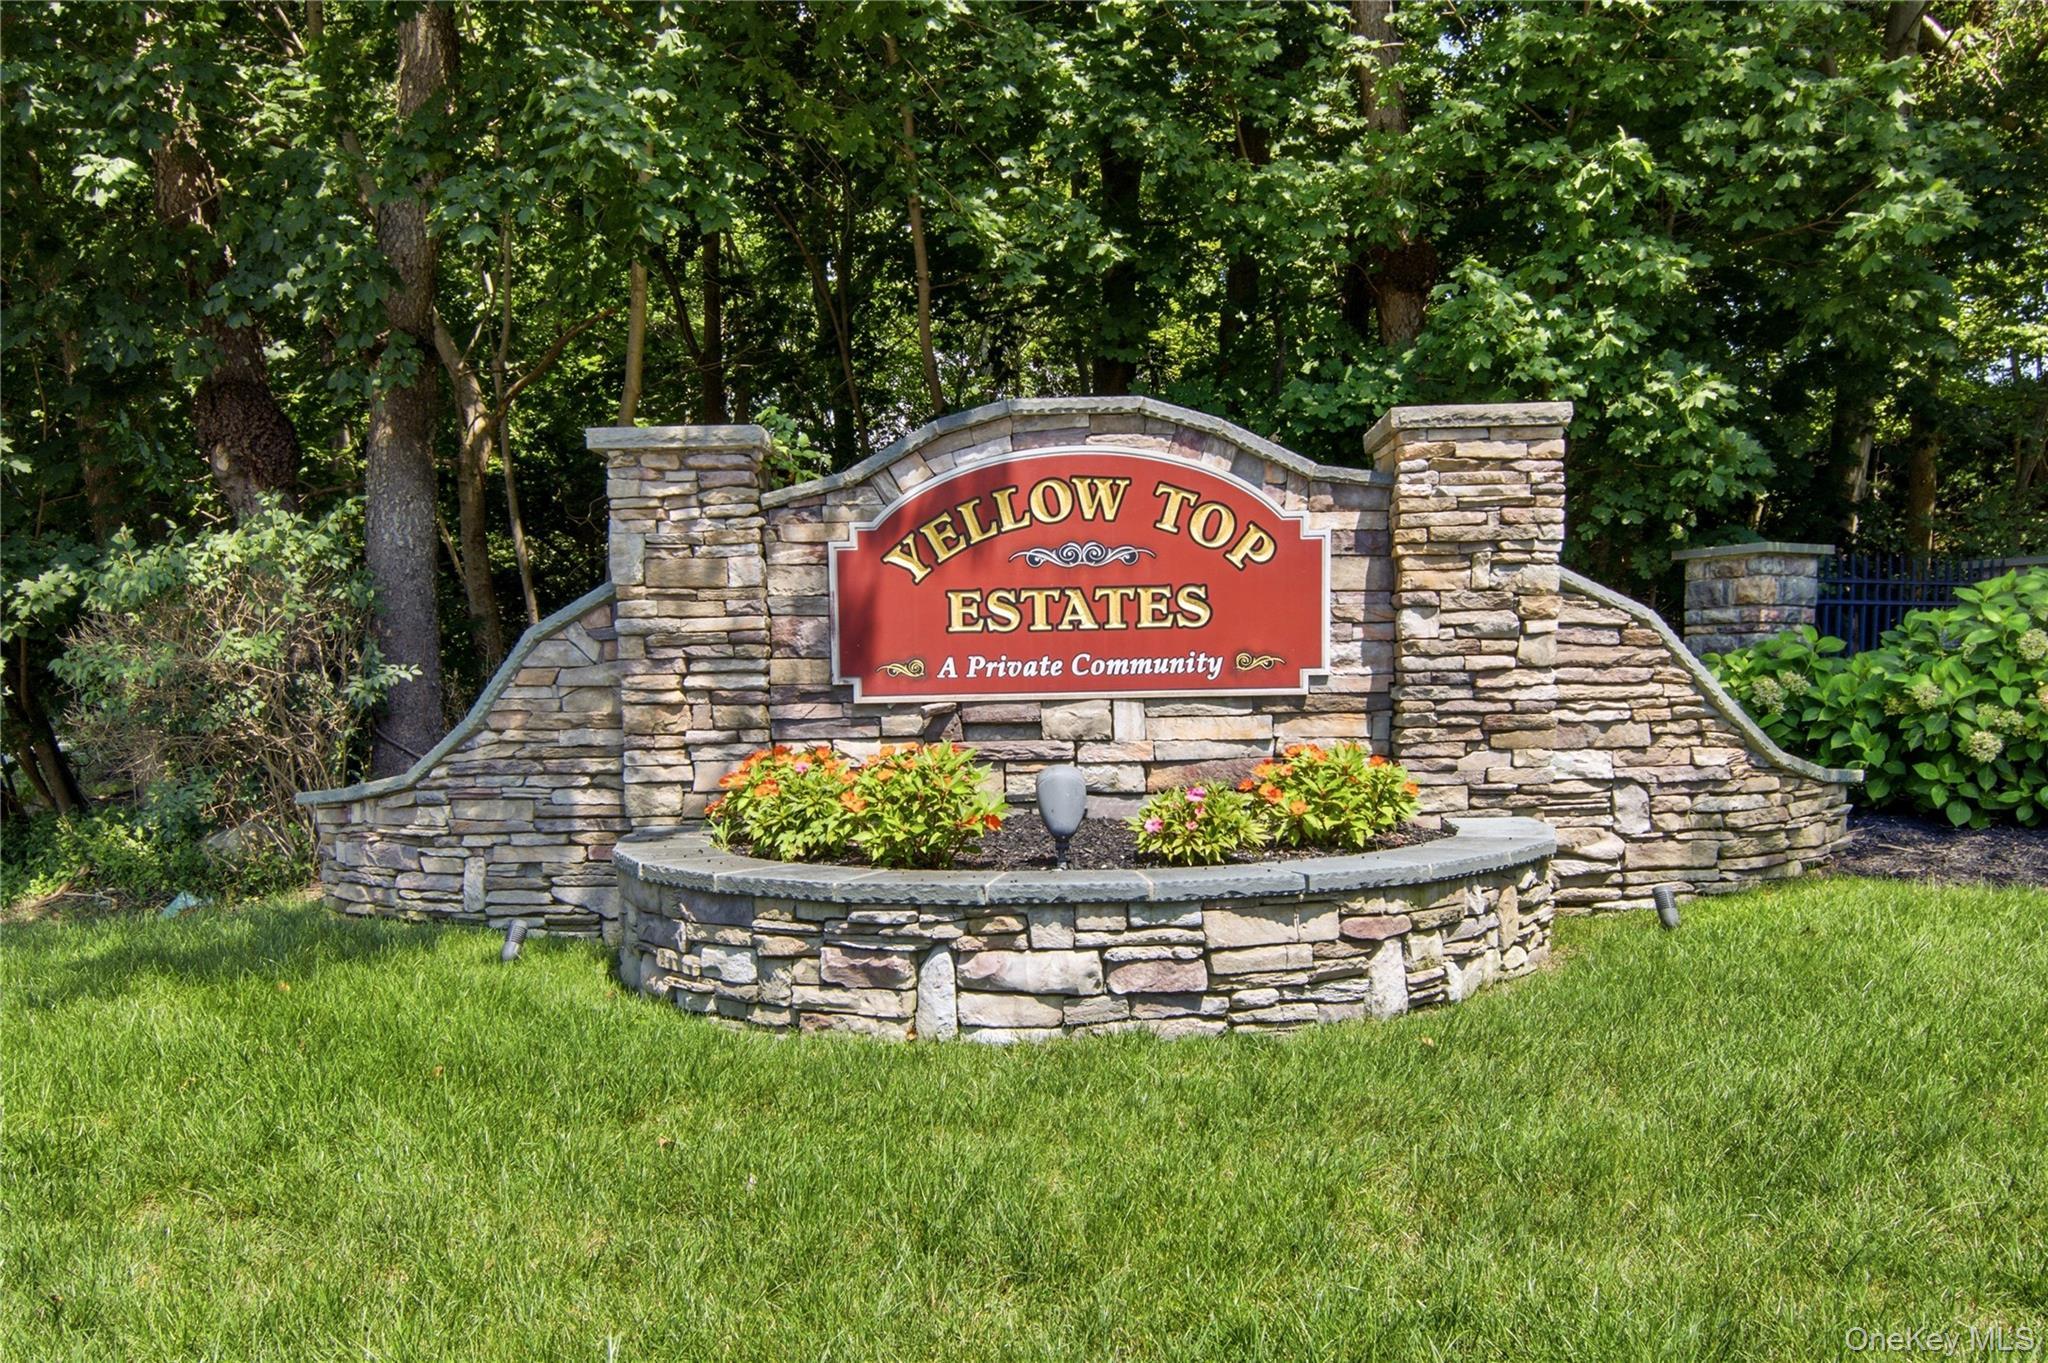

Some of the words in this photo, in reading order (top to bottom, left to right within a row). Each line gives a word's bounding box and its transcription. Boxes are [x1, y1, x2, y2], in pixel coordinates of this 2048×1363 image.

[882, 475, 1131, 584] YELLOW
[1154, 481, 1278, 571] TOP
[946, 584, 1212, 633] ESTATES
[938, 657, 958, 678] A
[967, 655, 1062, 678] Private
[1072, 651, 1223, 680] Community
